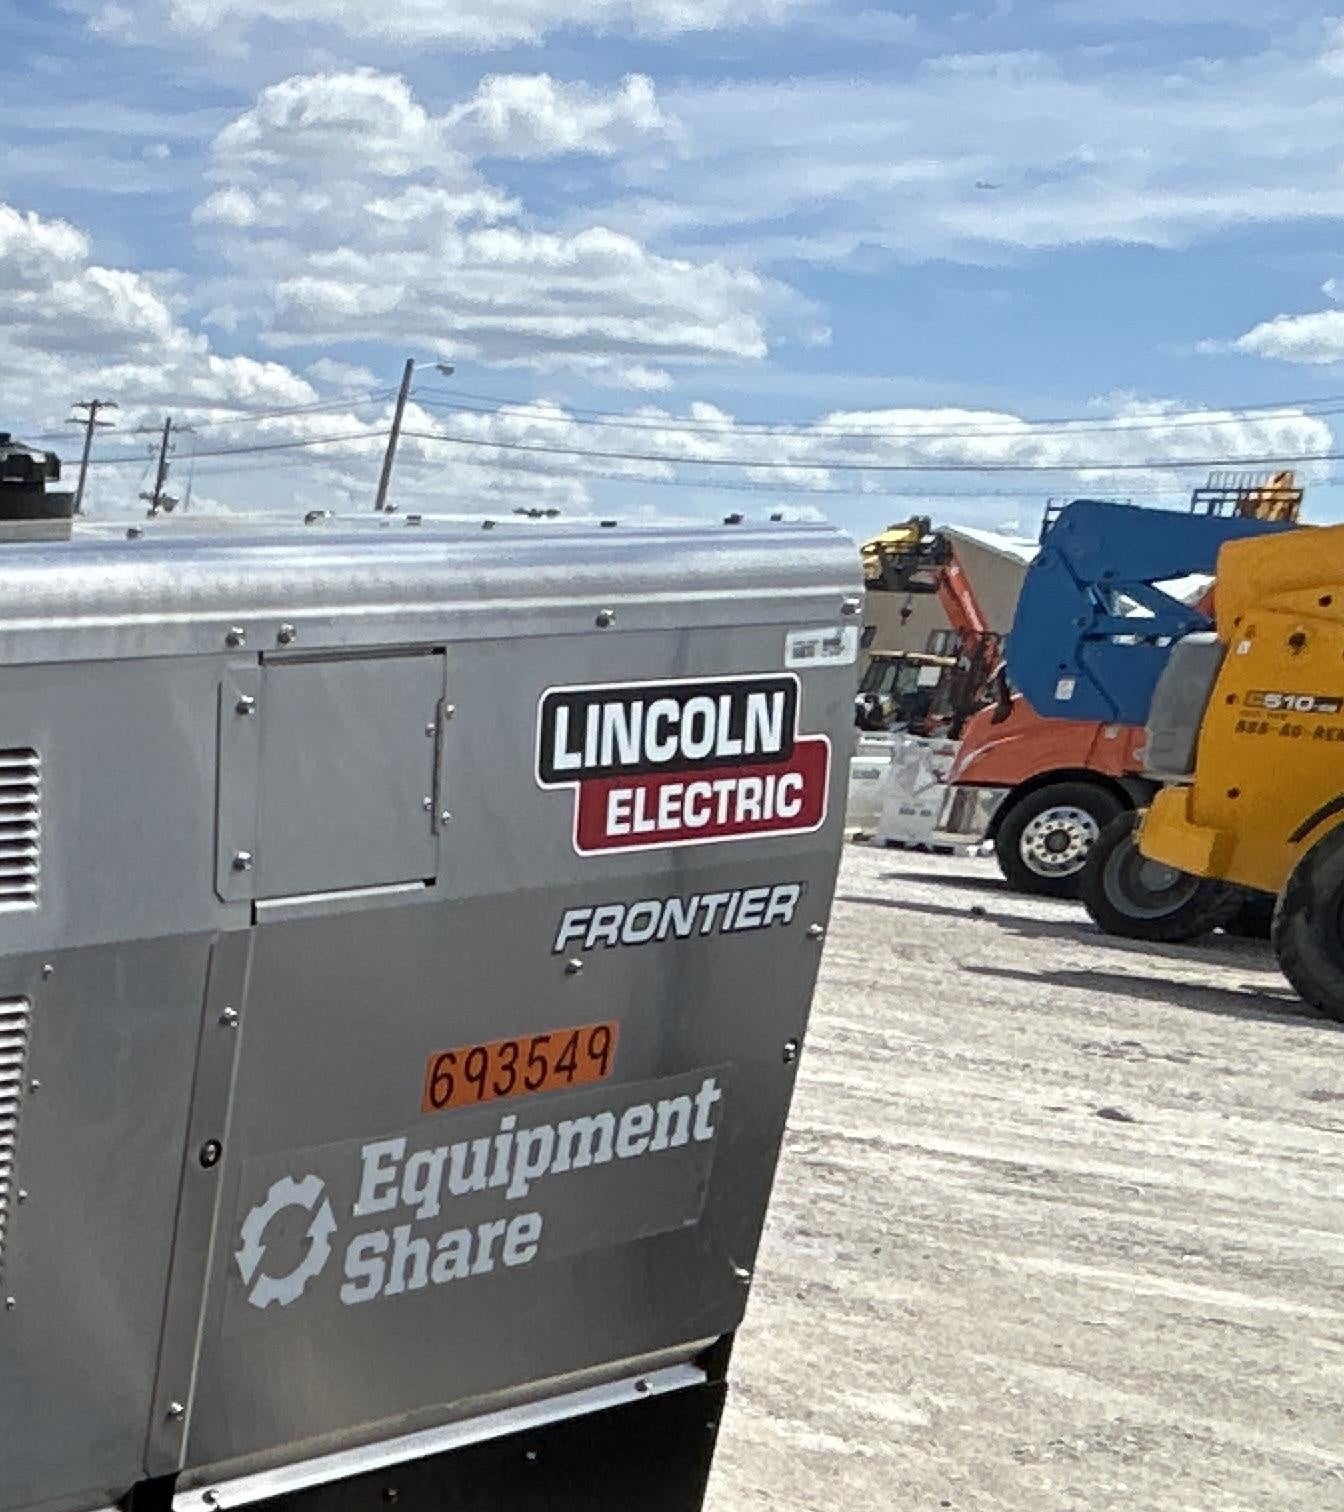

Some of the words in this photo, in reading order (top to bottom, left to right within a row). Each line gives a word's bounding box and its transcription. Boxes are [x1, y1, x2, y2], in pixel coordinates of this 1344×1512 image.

[552, 691, 786, 771] LINCOLN
[605, 772, 805, 837] ELECTRIC
[552, 883, 802, 954] FRONTIER
[428, 1024, 612, 1110] 693549
[353, 1078, 722, 1219] Equipment
[339, 1211, 543, 1305] Share
